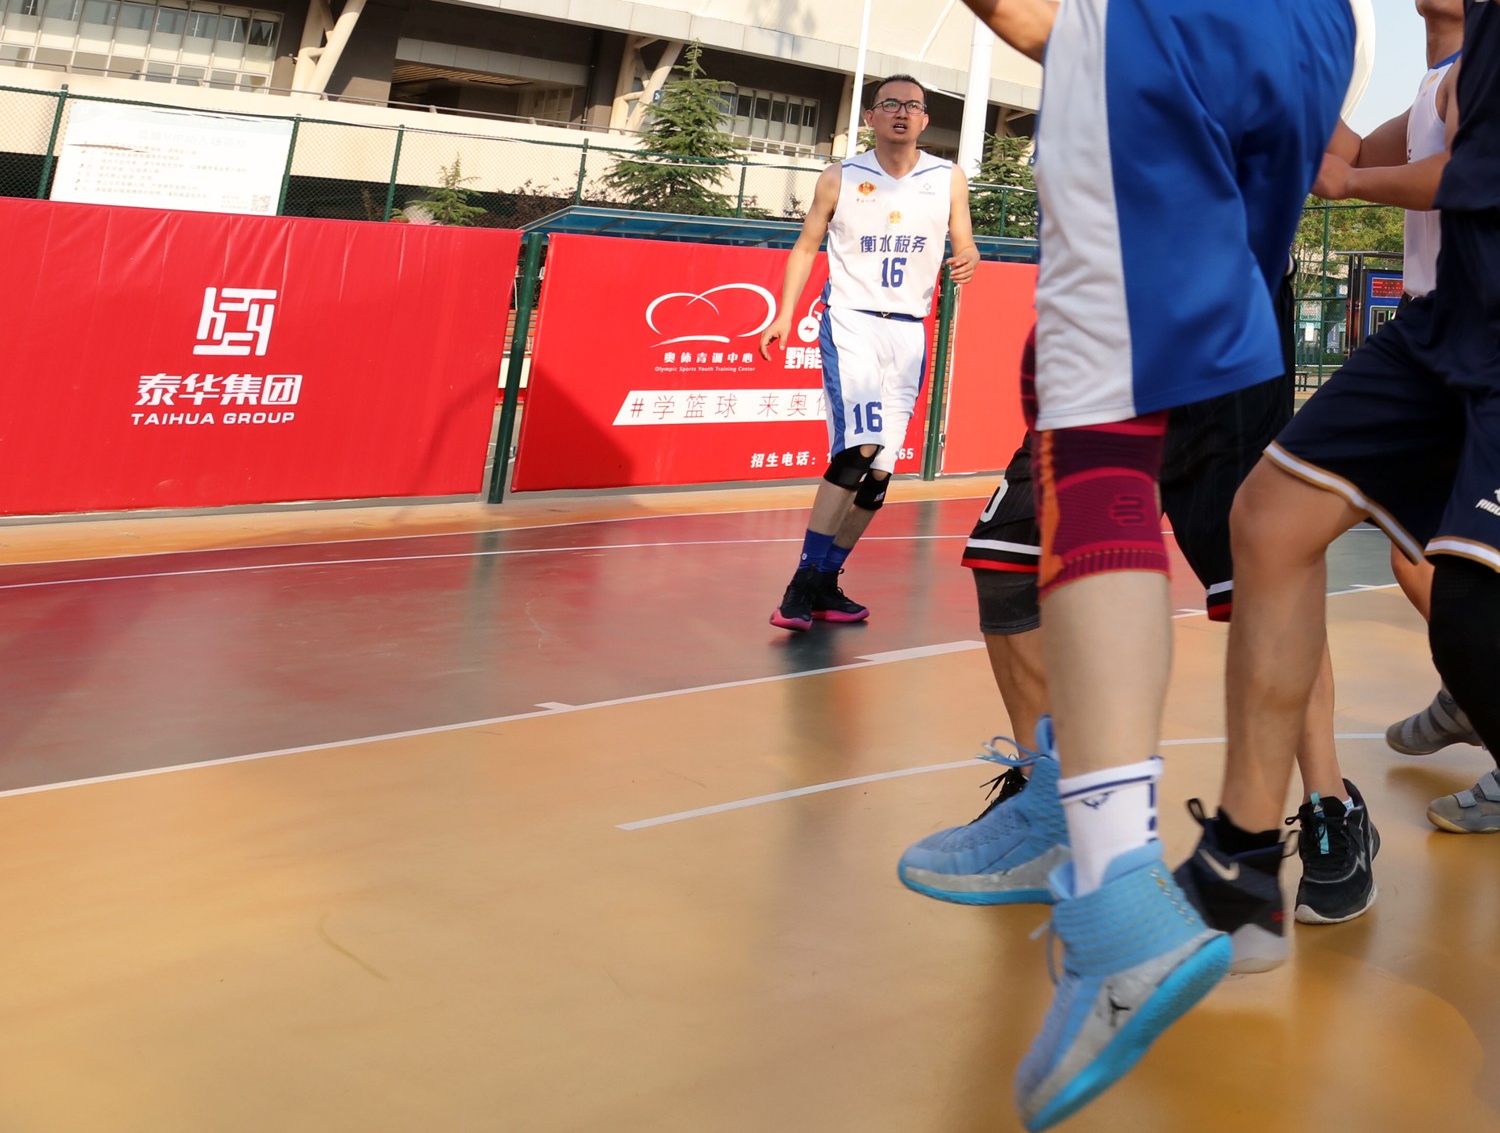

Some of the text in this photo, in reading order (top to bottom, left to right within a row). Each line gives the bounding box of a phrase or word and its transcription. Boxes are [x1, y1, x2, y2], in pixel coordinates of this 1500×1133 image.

[860, 234, 928, 254] 衡水税务
[881, 257, 908, 288] 16
[134, 372, 303, 406] 泰华集团
[131, 412, 296, 426] TAIHUA GROUP
[853, 401, 884, 435] 16
